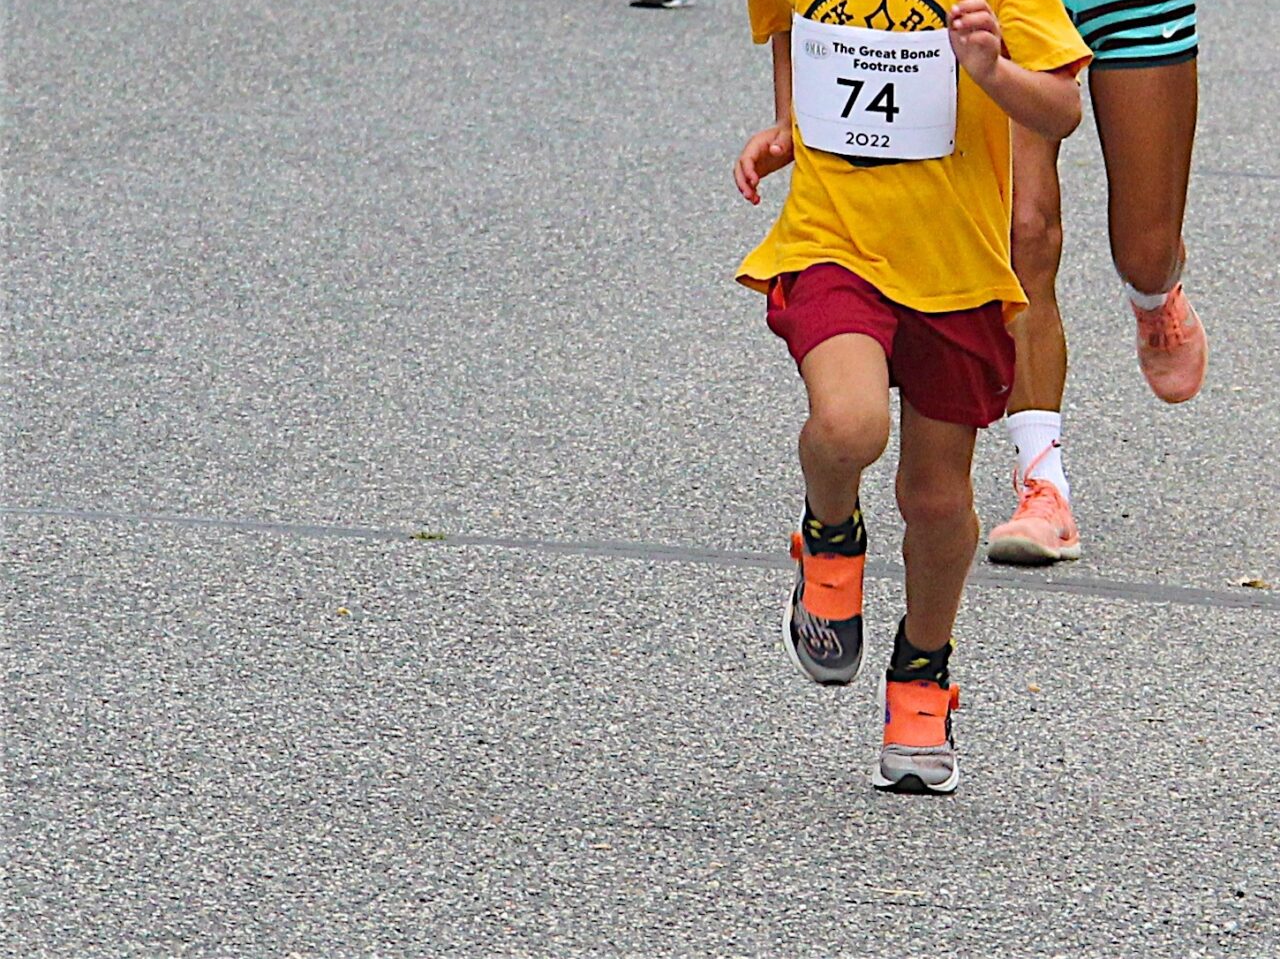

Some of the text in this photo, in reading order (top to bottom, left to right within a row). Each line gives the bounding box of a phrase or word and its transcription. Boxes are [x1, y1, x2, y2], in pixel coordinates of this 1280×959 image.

[832, 42, 940, 60] The Great Bonac
[853, 59, 919, 73] Footraces
[836, 77, 899, 123] 74
[845, 131, 890, 148] 2022
